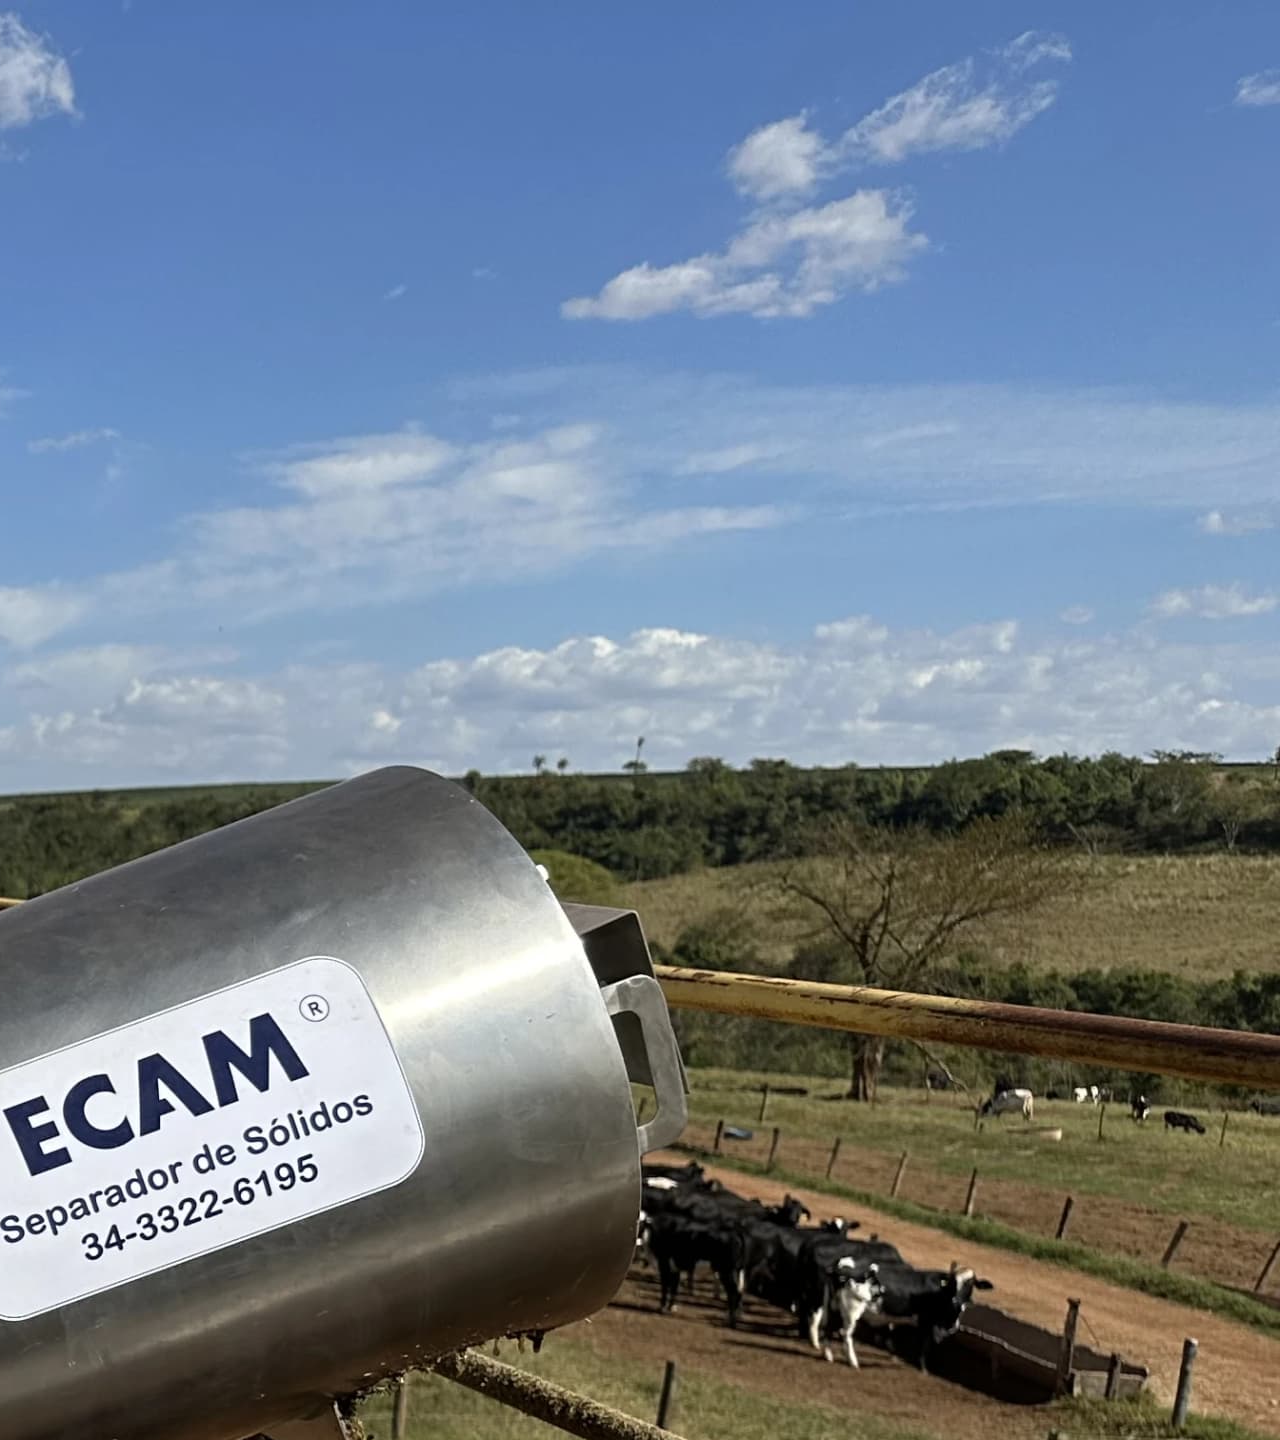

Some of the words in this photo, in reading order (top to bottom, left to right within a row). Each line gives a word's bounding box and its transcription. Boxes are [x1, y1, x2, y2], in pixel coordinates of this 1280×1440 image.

[0, 1161, 183, 1243] Separador
[193, 1144, 236, 1174] de
[243, 1094, 374, 1156] Sólidos
[3, 1012, 310, 1176] ECAM
[81, 1154, 319, 1262] 34-3322-6195
